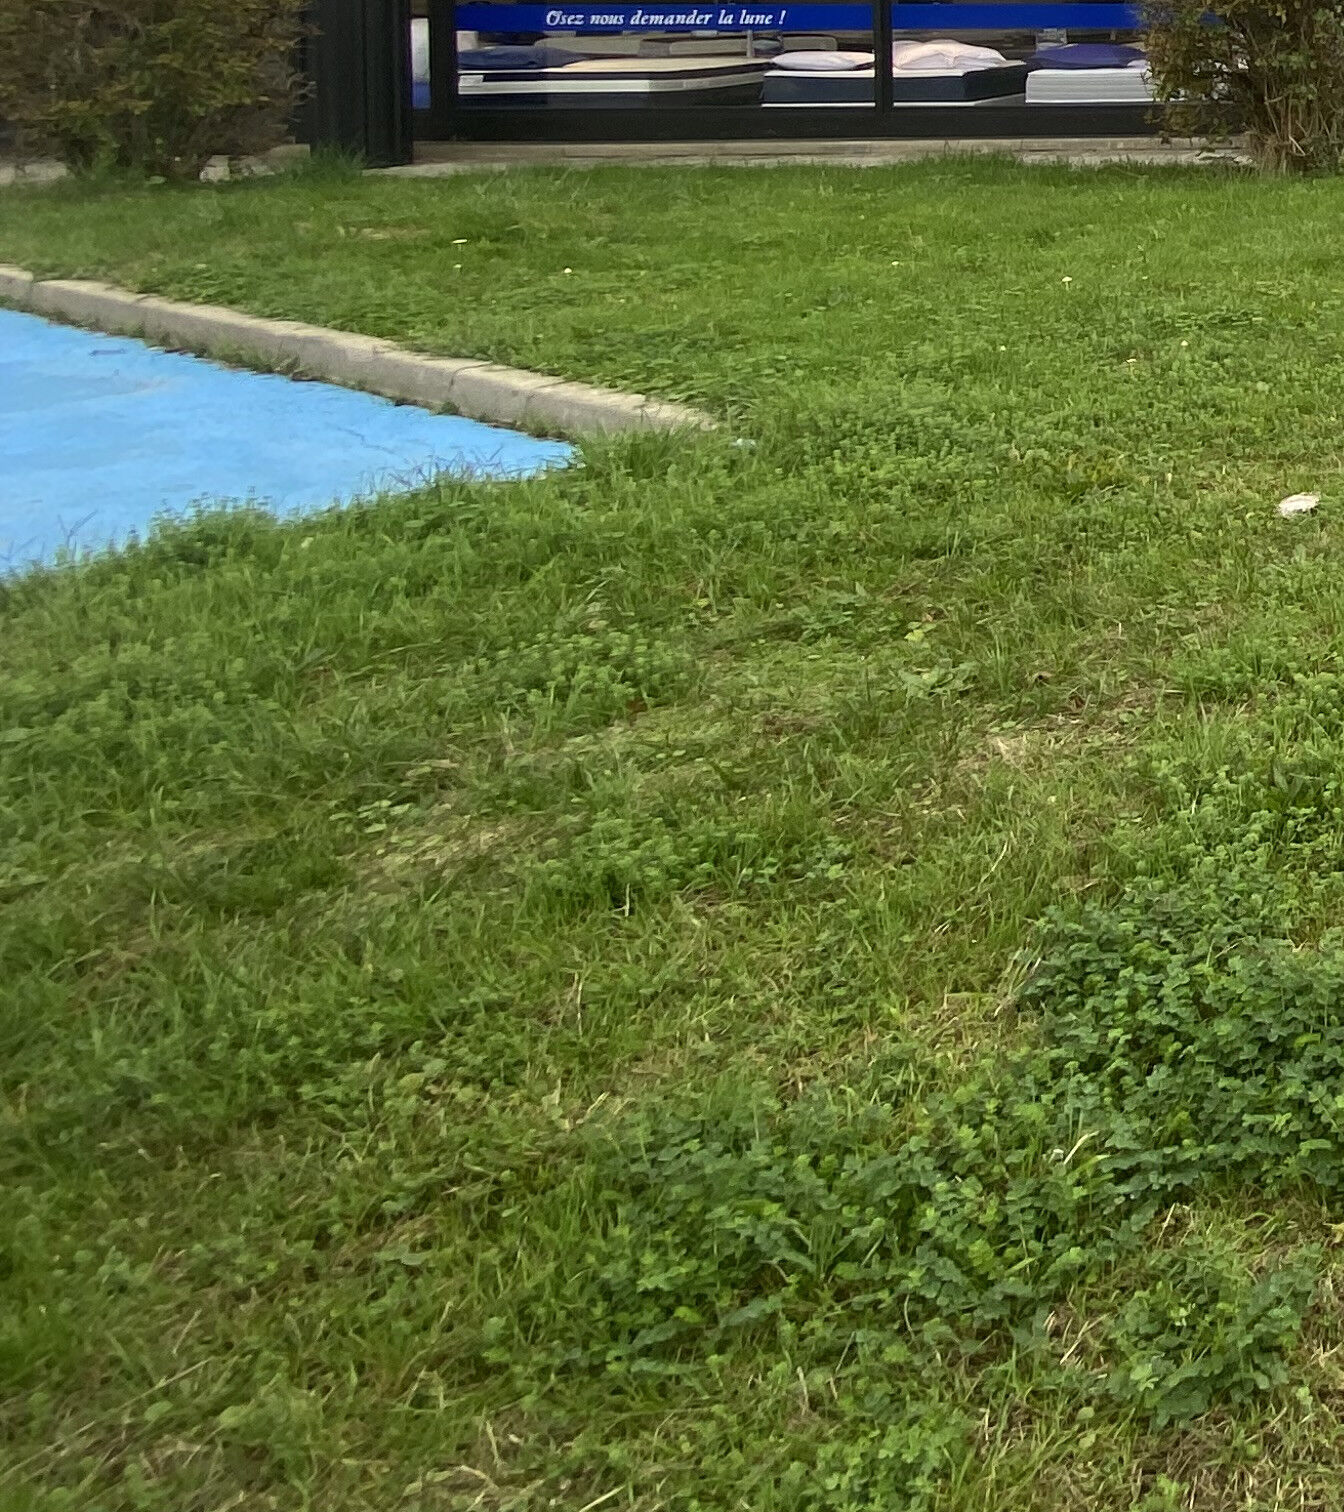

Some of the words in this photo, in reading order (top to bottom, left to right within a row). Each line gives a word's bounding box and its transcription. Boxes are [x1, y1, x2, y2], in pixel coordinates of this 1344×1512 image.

[546, 10, 584, 26] Osez
[590, 13, 624, 26] nous
[630, 9, 713, 26] demander
[718, 9, 734, 25] la
[739, 9, 774, 25] lune
